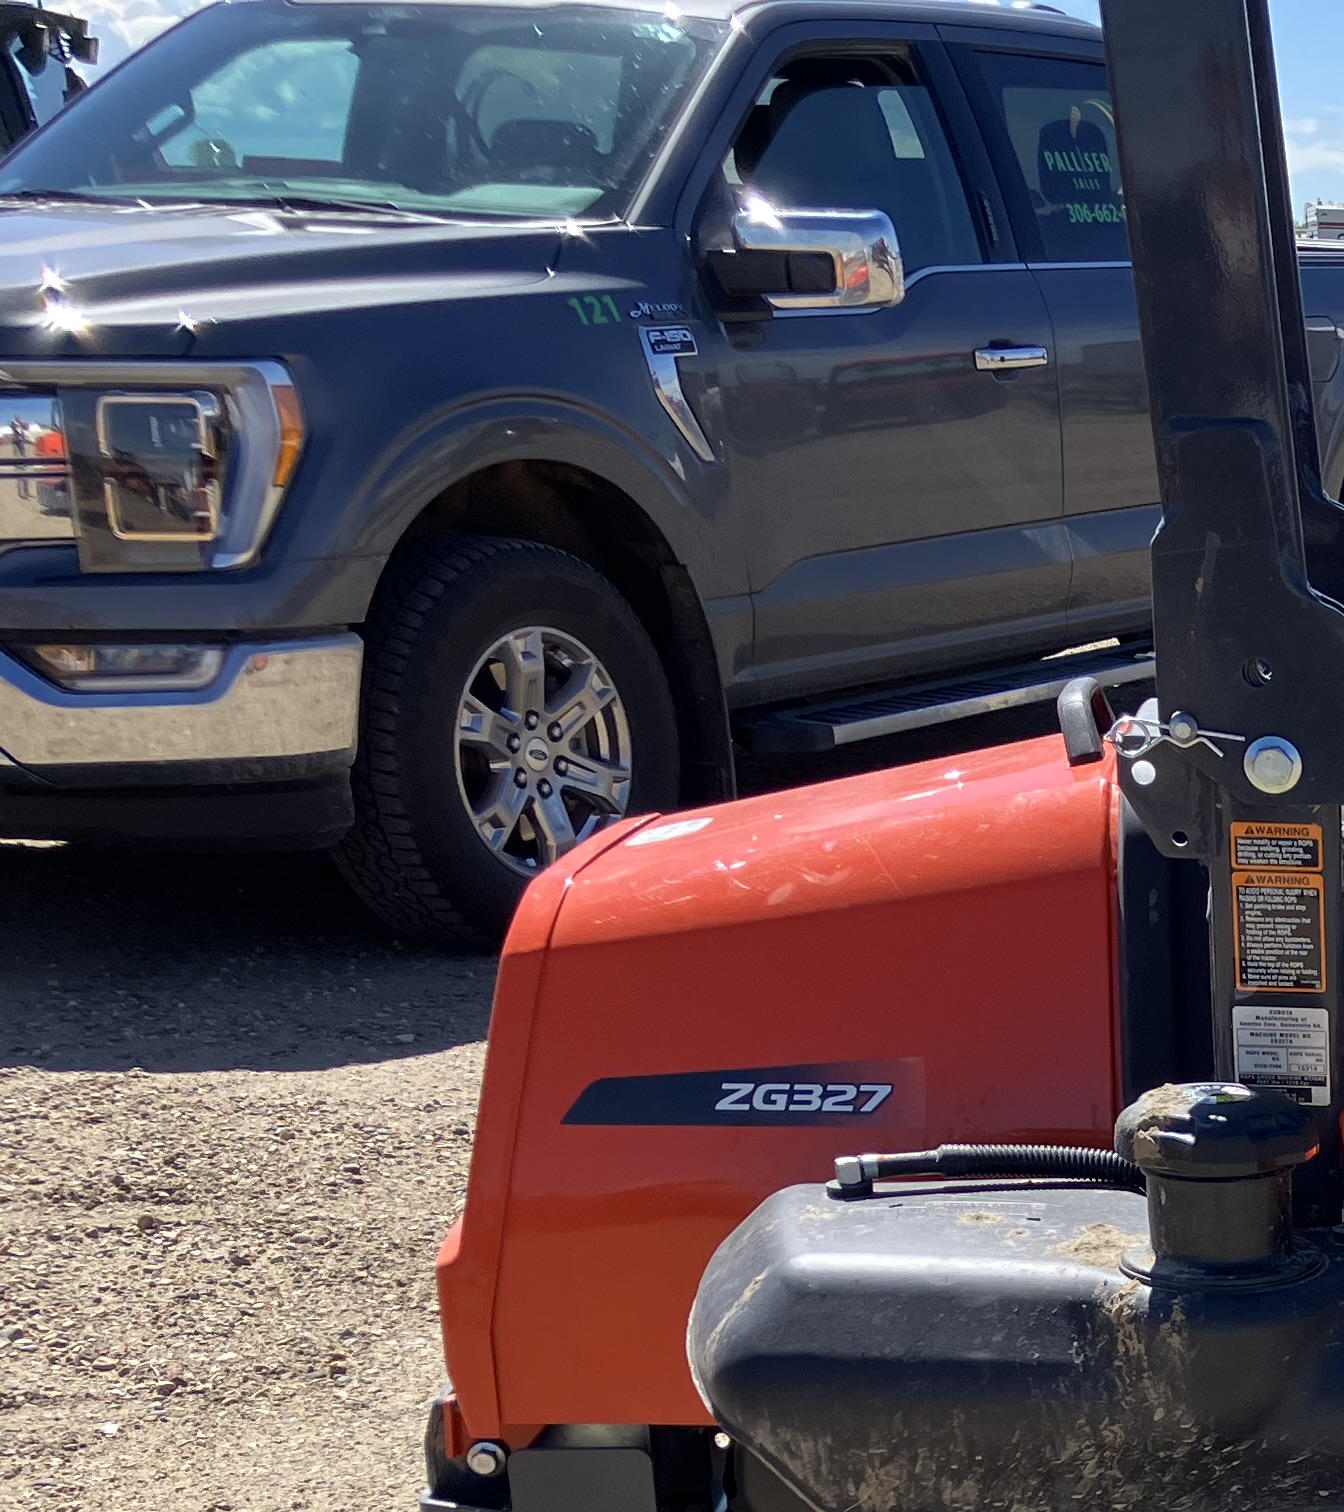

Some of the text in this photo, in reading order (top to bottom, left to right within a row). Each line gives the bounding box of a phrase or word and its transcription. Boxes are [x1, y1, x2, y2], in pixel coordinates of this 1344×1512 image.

[1043, 148, 1112, 173] PALLISER
[567, 293, 623, 326] 121
[648, 329, 692, 344] F-150
[1255, 825, 1310, 837] WARNING
[1256, 875, 1310, 886] WARNING
[714, 1083, 893, 1112] ZG327
